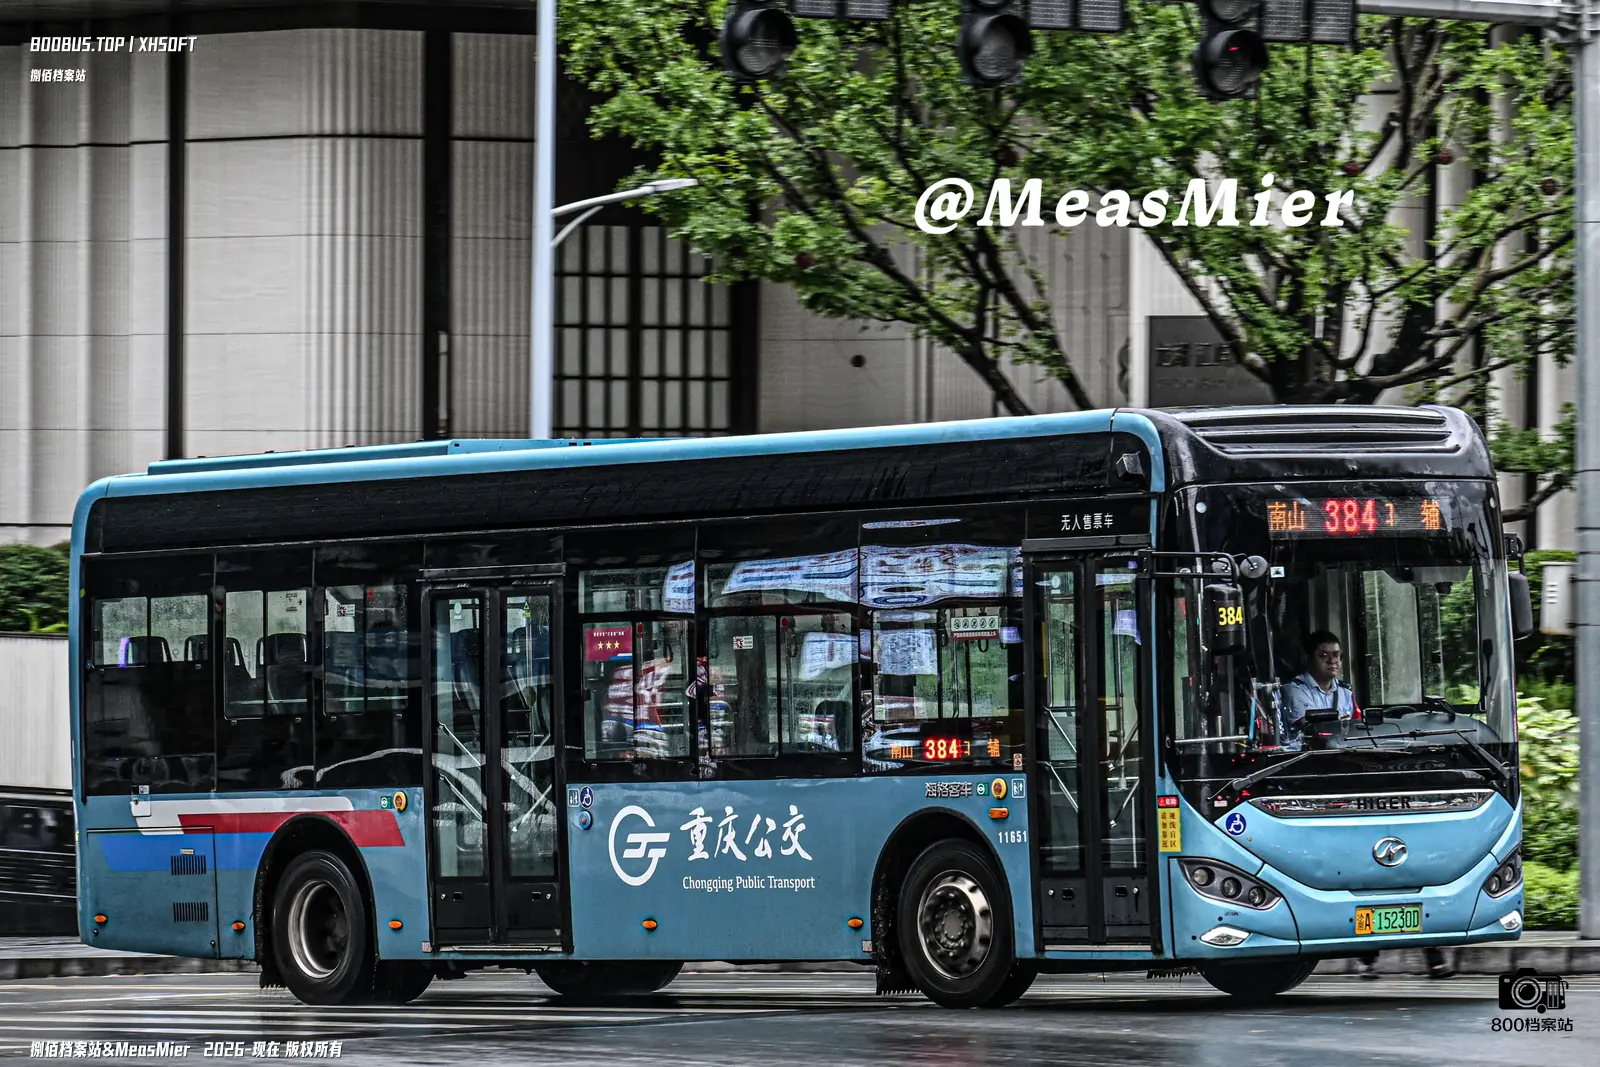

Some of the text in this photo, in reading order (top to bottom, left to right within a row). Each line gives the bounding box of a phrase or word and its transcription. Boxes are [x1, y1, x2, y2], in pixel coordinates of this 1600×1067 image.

[1061, 512, 1114, 531] 无人售票车
[1267, 501, 1305, 531] 南山
[1324, 499, 1378, 533] 384
[1218, 606, 1243, 626] 384
[925, 738, 959, 760] 384
[925, 781, 974, 798] 海格客车
[1356, 796, 1411, 810] HIGER
[680, 804, 813, 861] 重庆公交
[998, 830, 1028, 844] 11651
[682, 875, 815, 892] Chongqing Public Transport
[1378, 910, 1419, 930] 15230D
